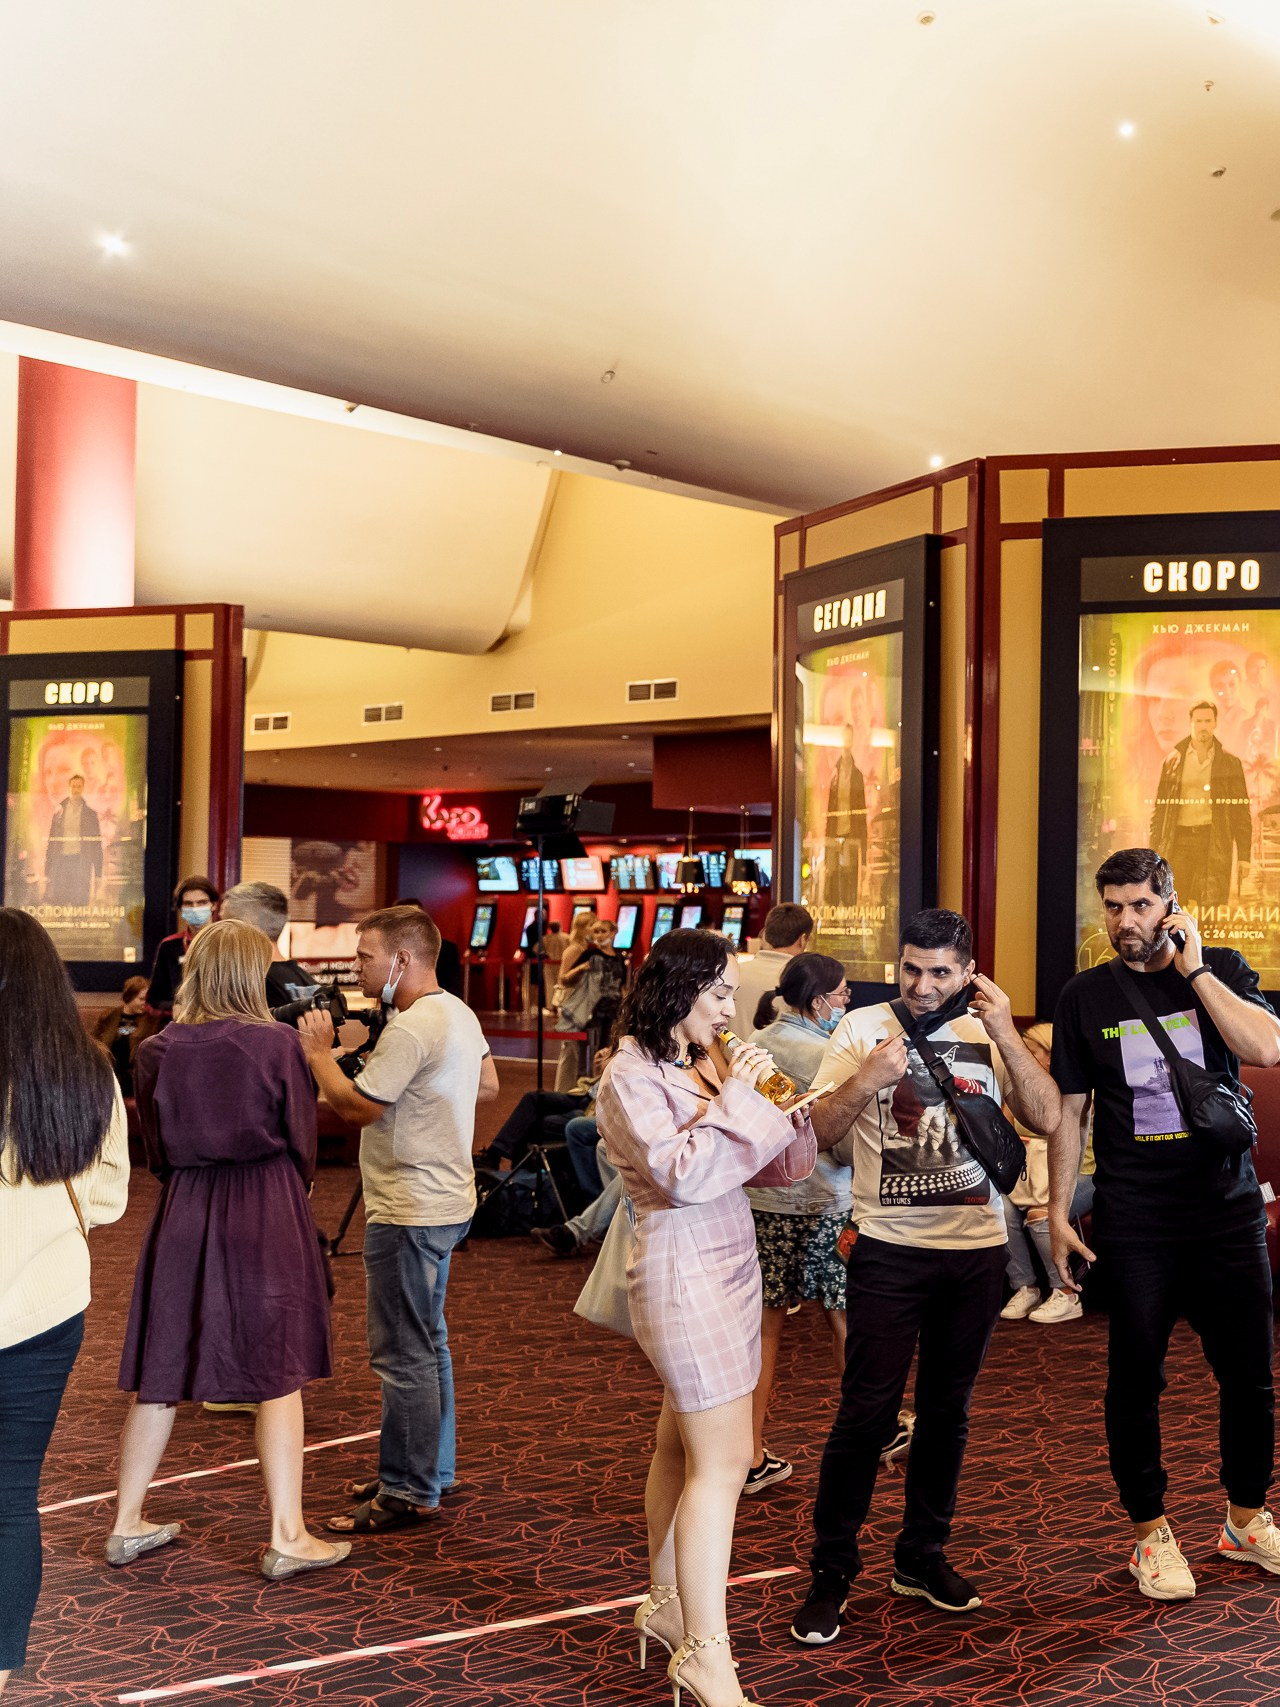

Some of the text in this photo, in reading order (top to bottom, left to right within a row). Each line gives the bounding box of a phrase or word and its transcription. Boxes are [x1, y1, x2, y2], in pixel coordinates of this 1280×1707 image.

[1143, 559, 1260, 593] СКОРО
[813, 589, 887, 633] СЕГОДНЯ
[1152, 622, 1250, 635] ХЬЮ ДЖЕКМАН
[44, 681, 114, 705] СКОРО
[1213, 930, 1226, 939] 26
[1228, 931, 1265, 939] АВГУСТА
[1101, 1025, 1127, 1040] THE
